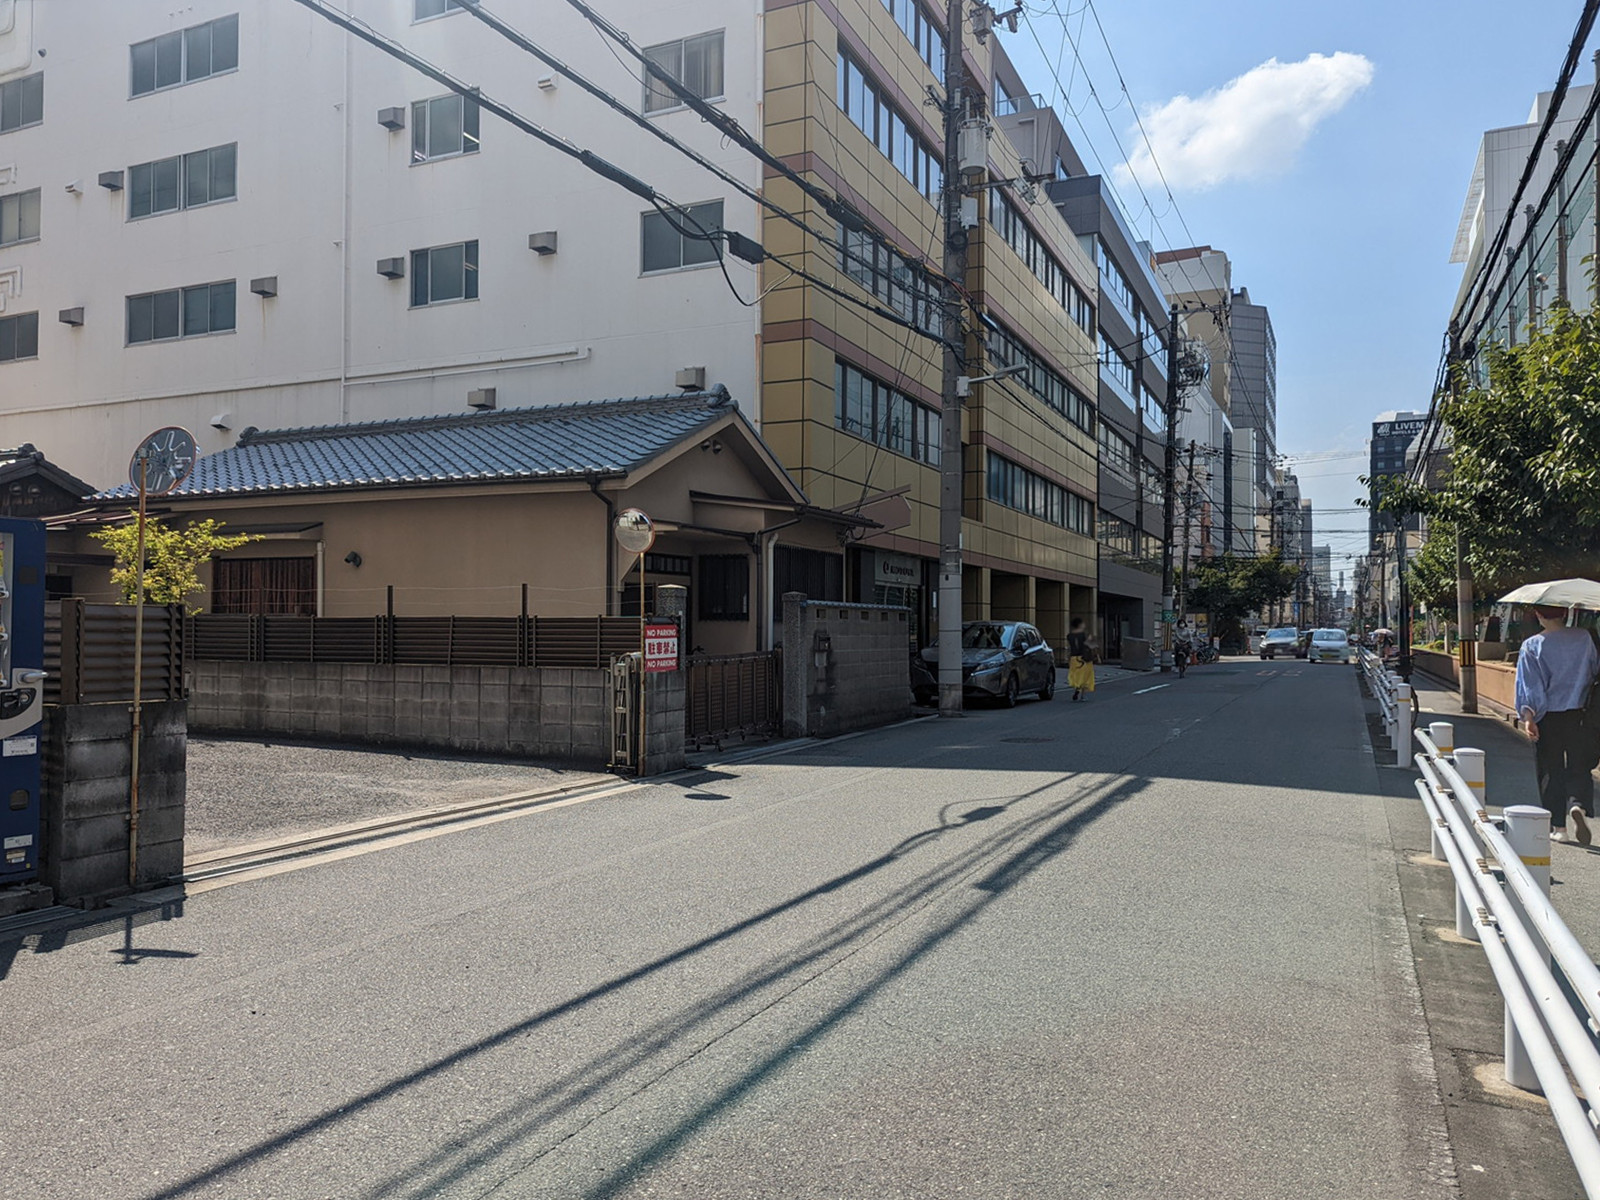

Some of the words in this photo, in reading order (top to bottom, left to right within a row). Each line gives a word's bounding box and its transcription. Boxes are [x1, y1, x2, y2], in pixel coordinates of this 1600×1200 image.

[647, 629, 656, 637] NO
[657, 629, 676, 637] PARKING
[648, 642, 676, 655] 駐車禁止
[647, 660, 656, 668] NO
[657, 659, 676, 668] PARKING
